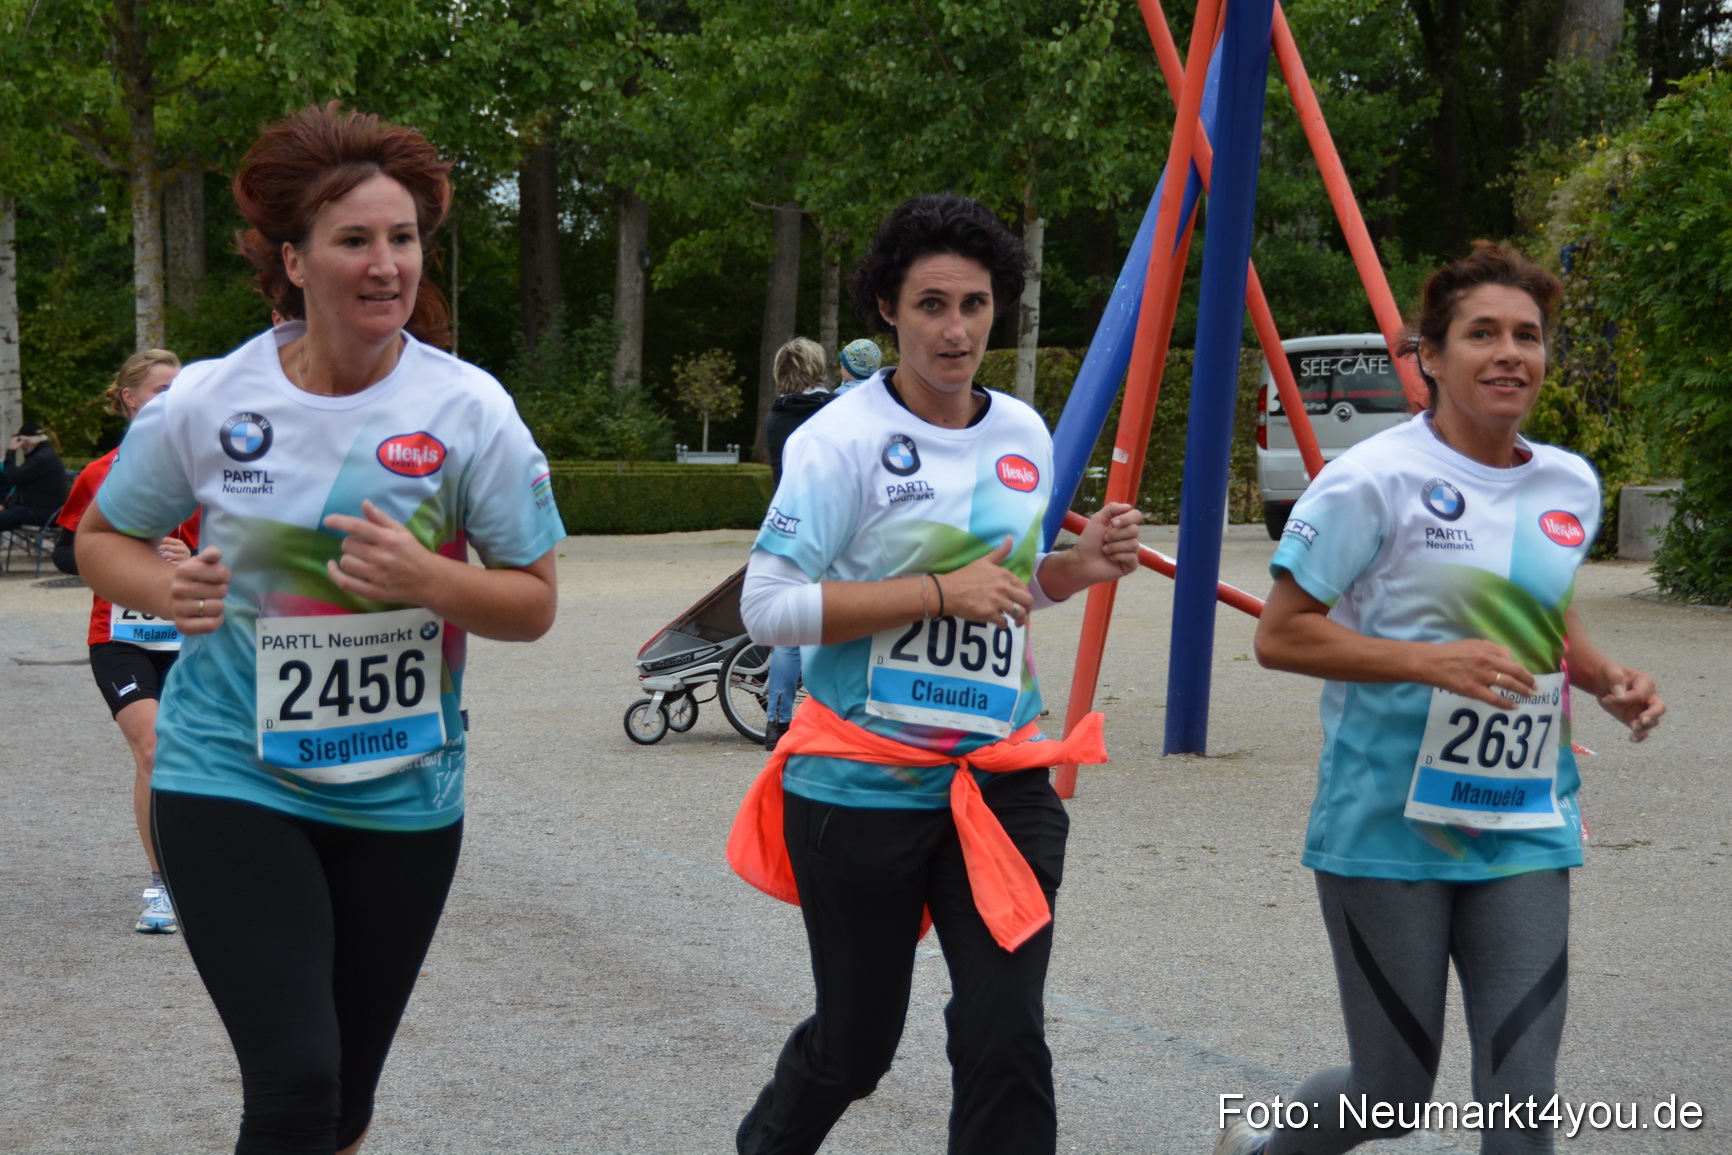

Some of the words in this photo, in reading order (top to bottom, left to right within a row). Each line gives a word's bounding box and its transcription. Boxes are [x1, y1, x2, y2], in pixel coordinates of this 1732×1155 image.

[388, 443, 438, 466] Hervis
[223, 469, 275, 484] PARTL
[1001, 462, 1035, 483] Hervis
[222, 483, 274, 494] Neumarkt
[886, 480, 934, 497] PARTL
[1425, 527, 1473, 541] PARTL
[1544, 518, 1580, 539] Hervis
[1426, 540, 1474, 550] Neumarkt
[133, 628, 178, 641] Melanie
[262, 634, 323, 650] PARTL
[328, 628, 413, 648] Neumarkt
[889, 614, 1013, 678] 2059
[877, 655, 884, 665] D
[279, 649, 425, 721] 2456
[912, 679, 989, 710] Claudia
[266, 718, 274, 729] D
[299, 727, 409, 763] Sieglinde
[1439, 707, 1553, 770] 2637
[1425, 755, 1432, 765] D
[1451, 781, 1526, 807] Manuela
